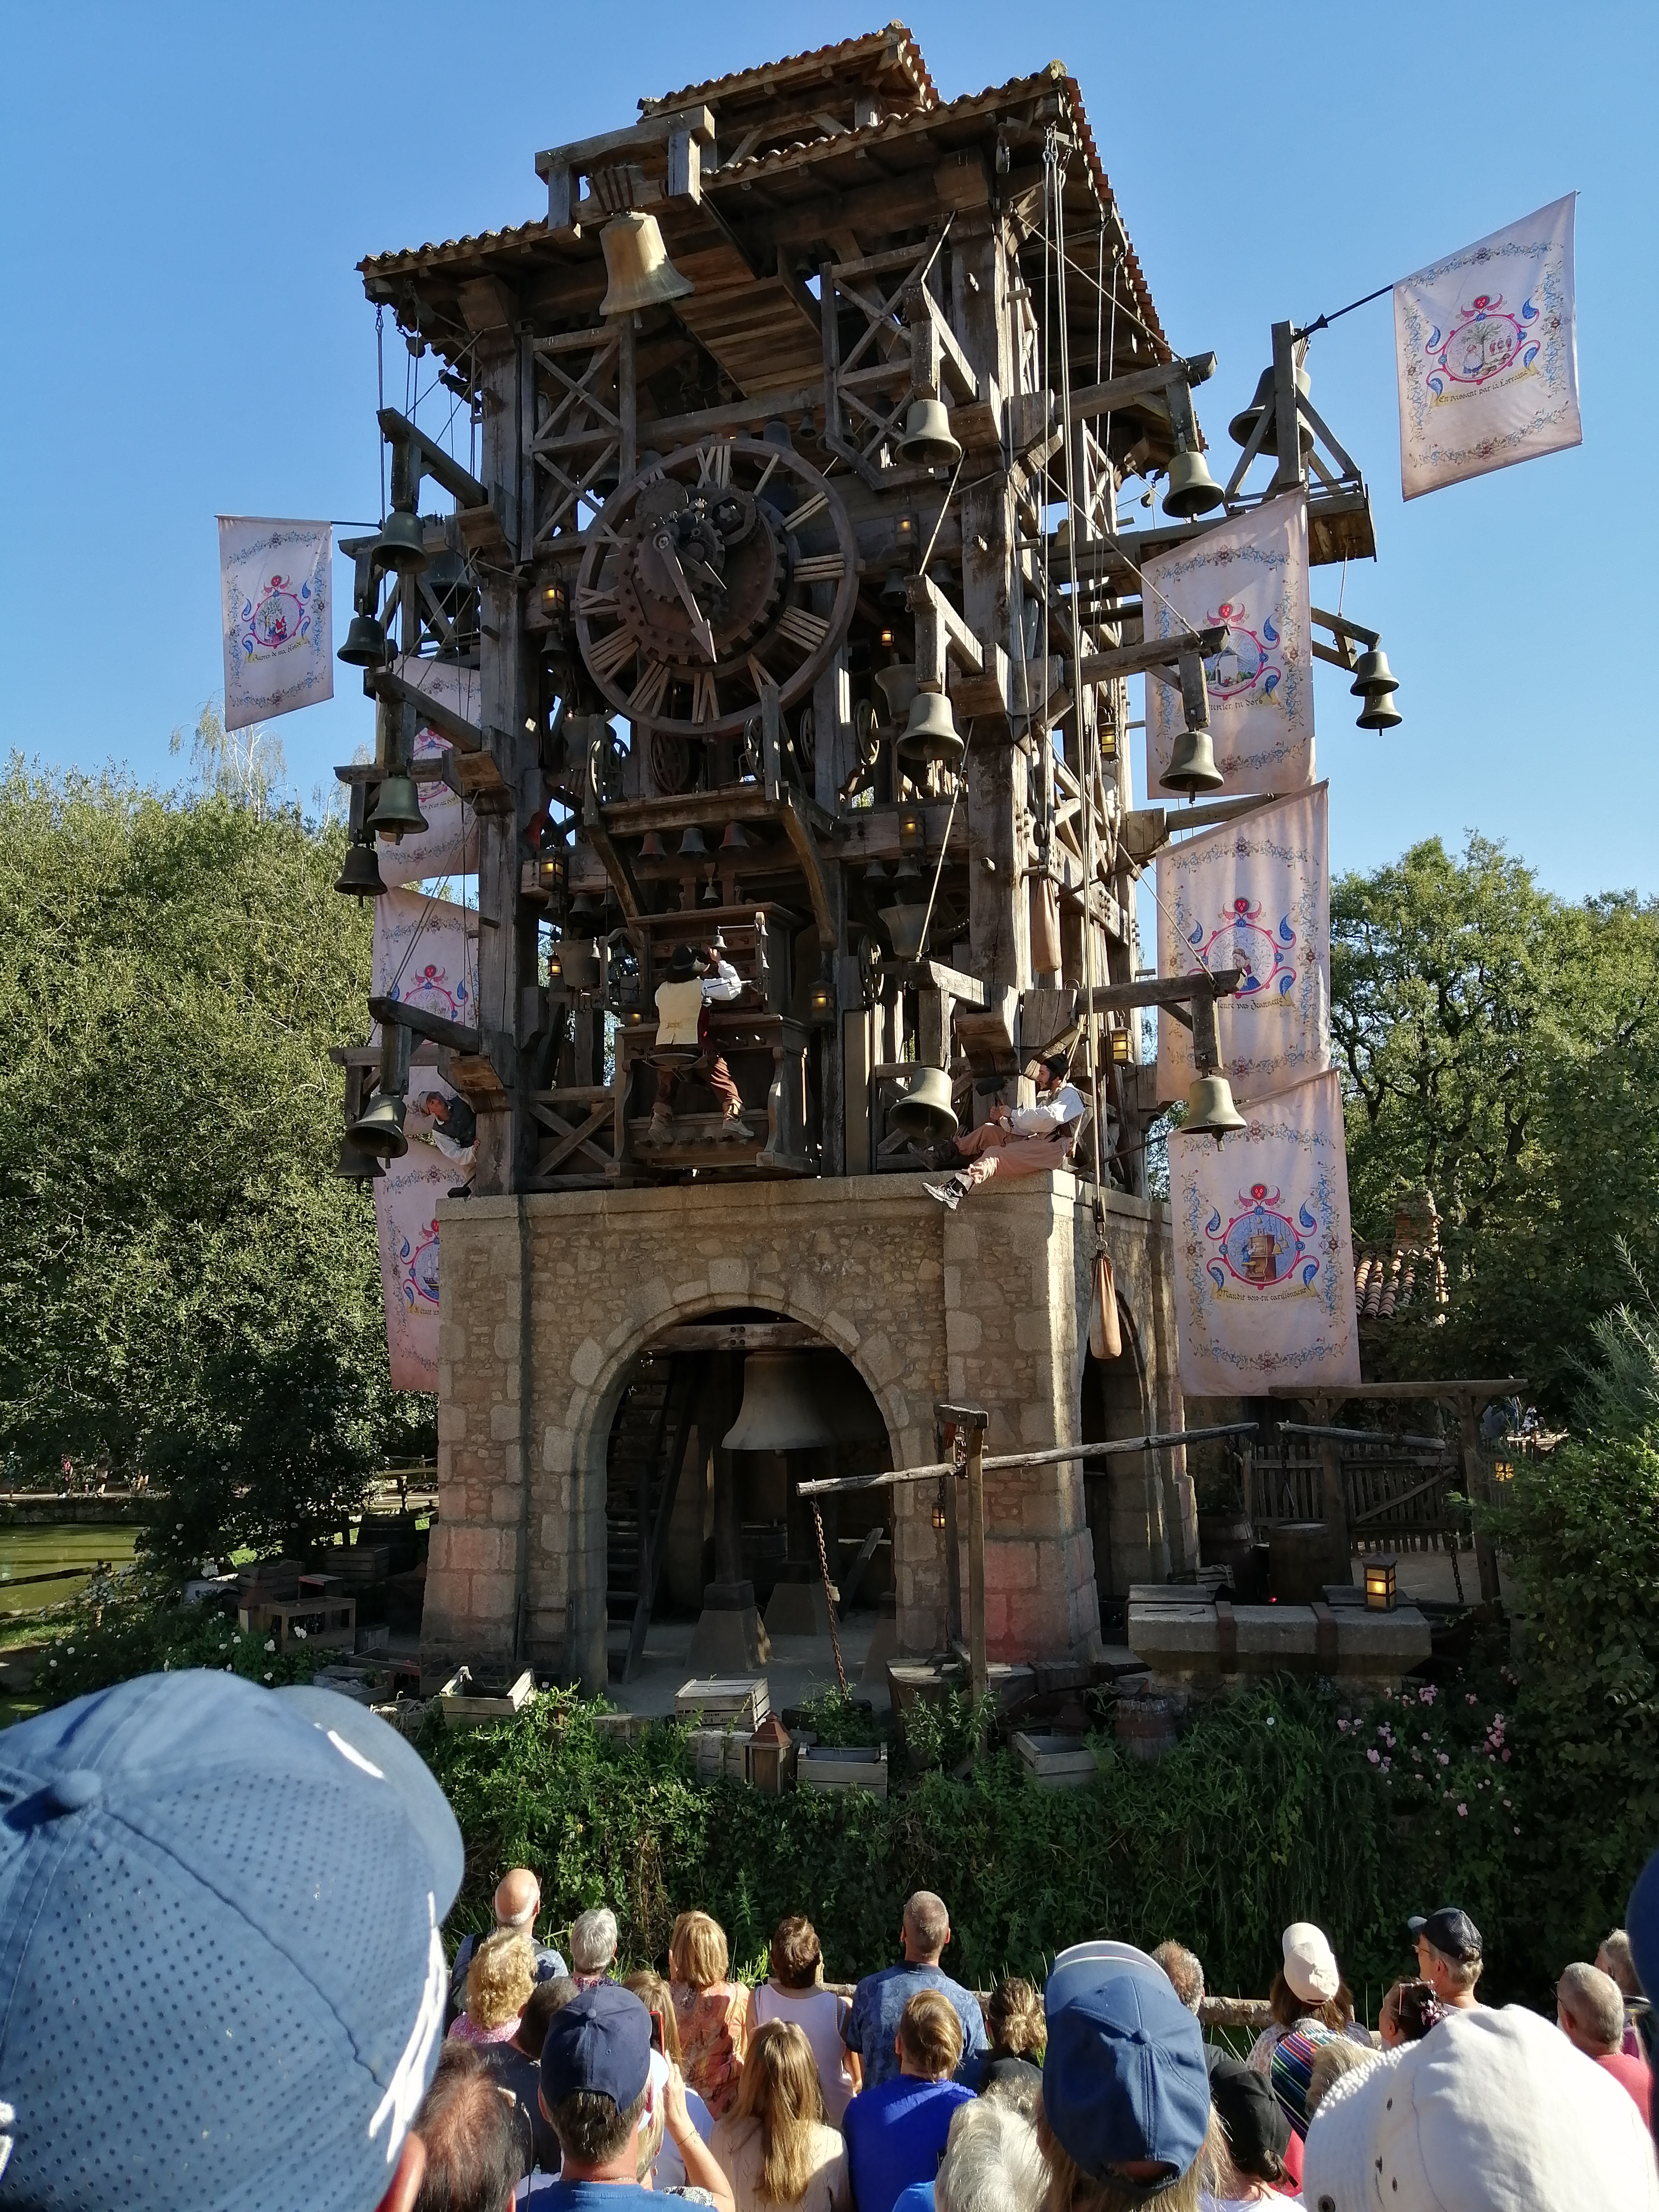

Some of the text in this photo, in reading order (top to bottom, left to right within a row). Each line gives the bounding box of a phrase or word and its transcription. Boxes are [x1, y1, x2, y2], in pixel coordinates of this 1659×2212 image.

[1451, 391, 1477, 402] passant
[1479, 387, 1491, 395] par
[1500, 370, 1528, 387] Lorraine
[1251, 998, 1283, 1010] Jeannette
[1218, 1289, 1245, 1300] Maudit
[1270, 1287, 1307, 1300] carillonneur
